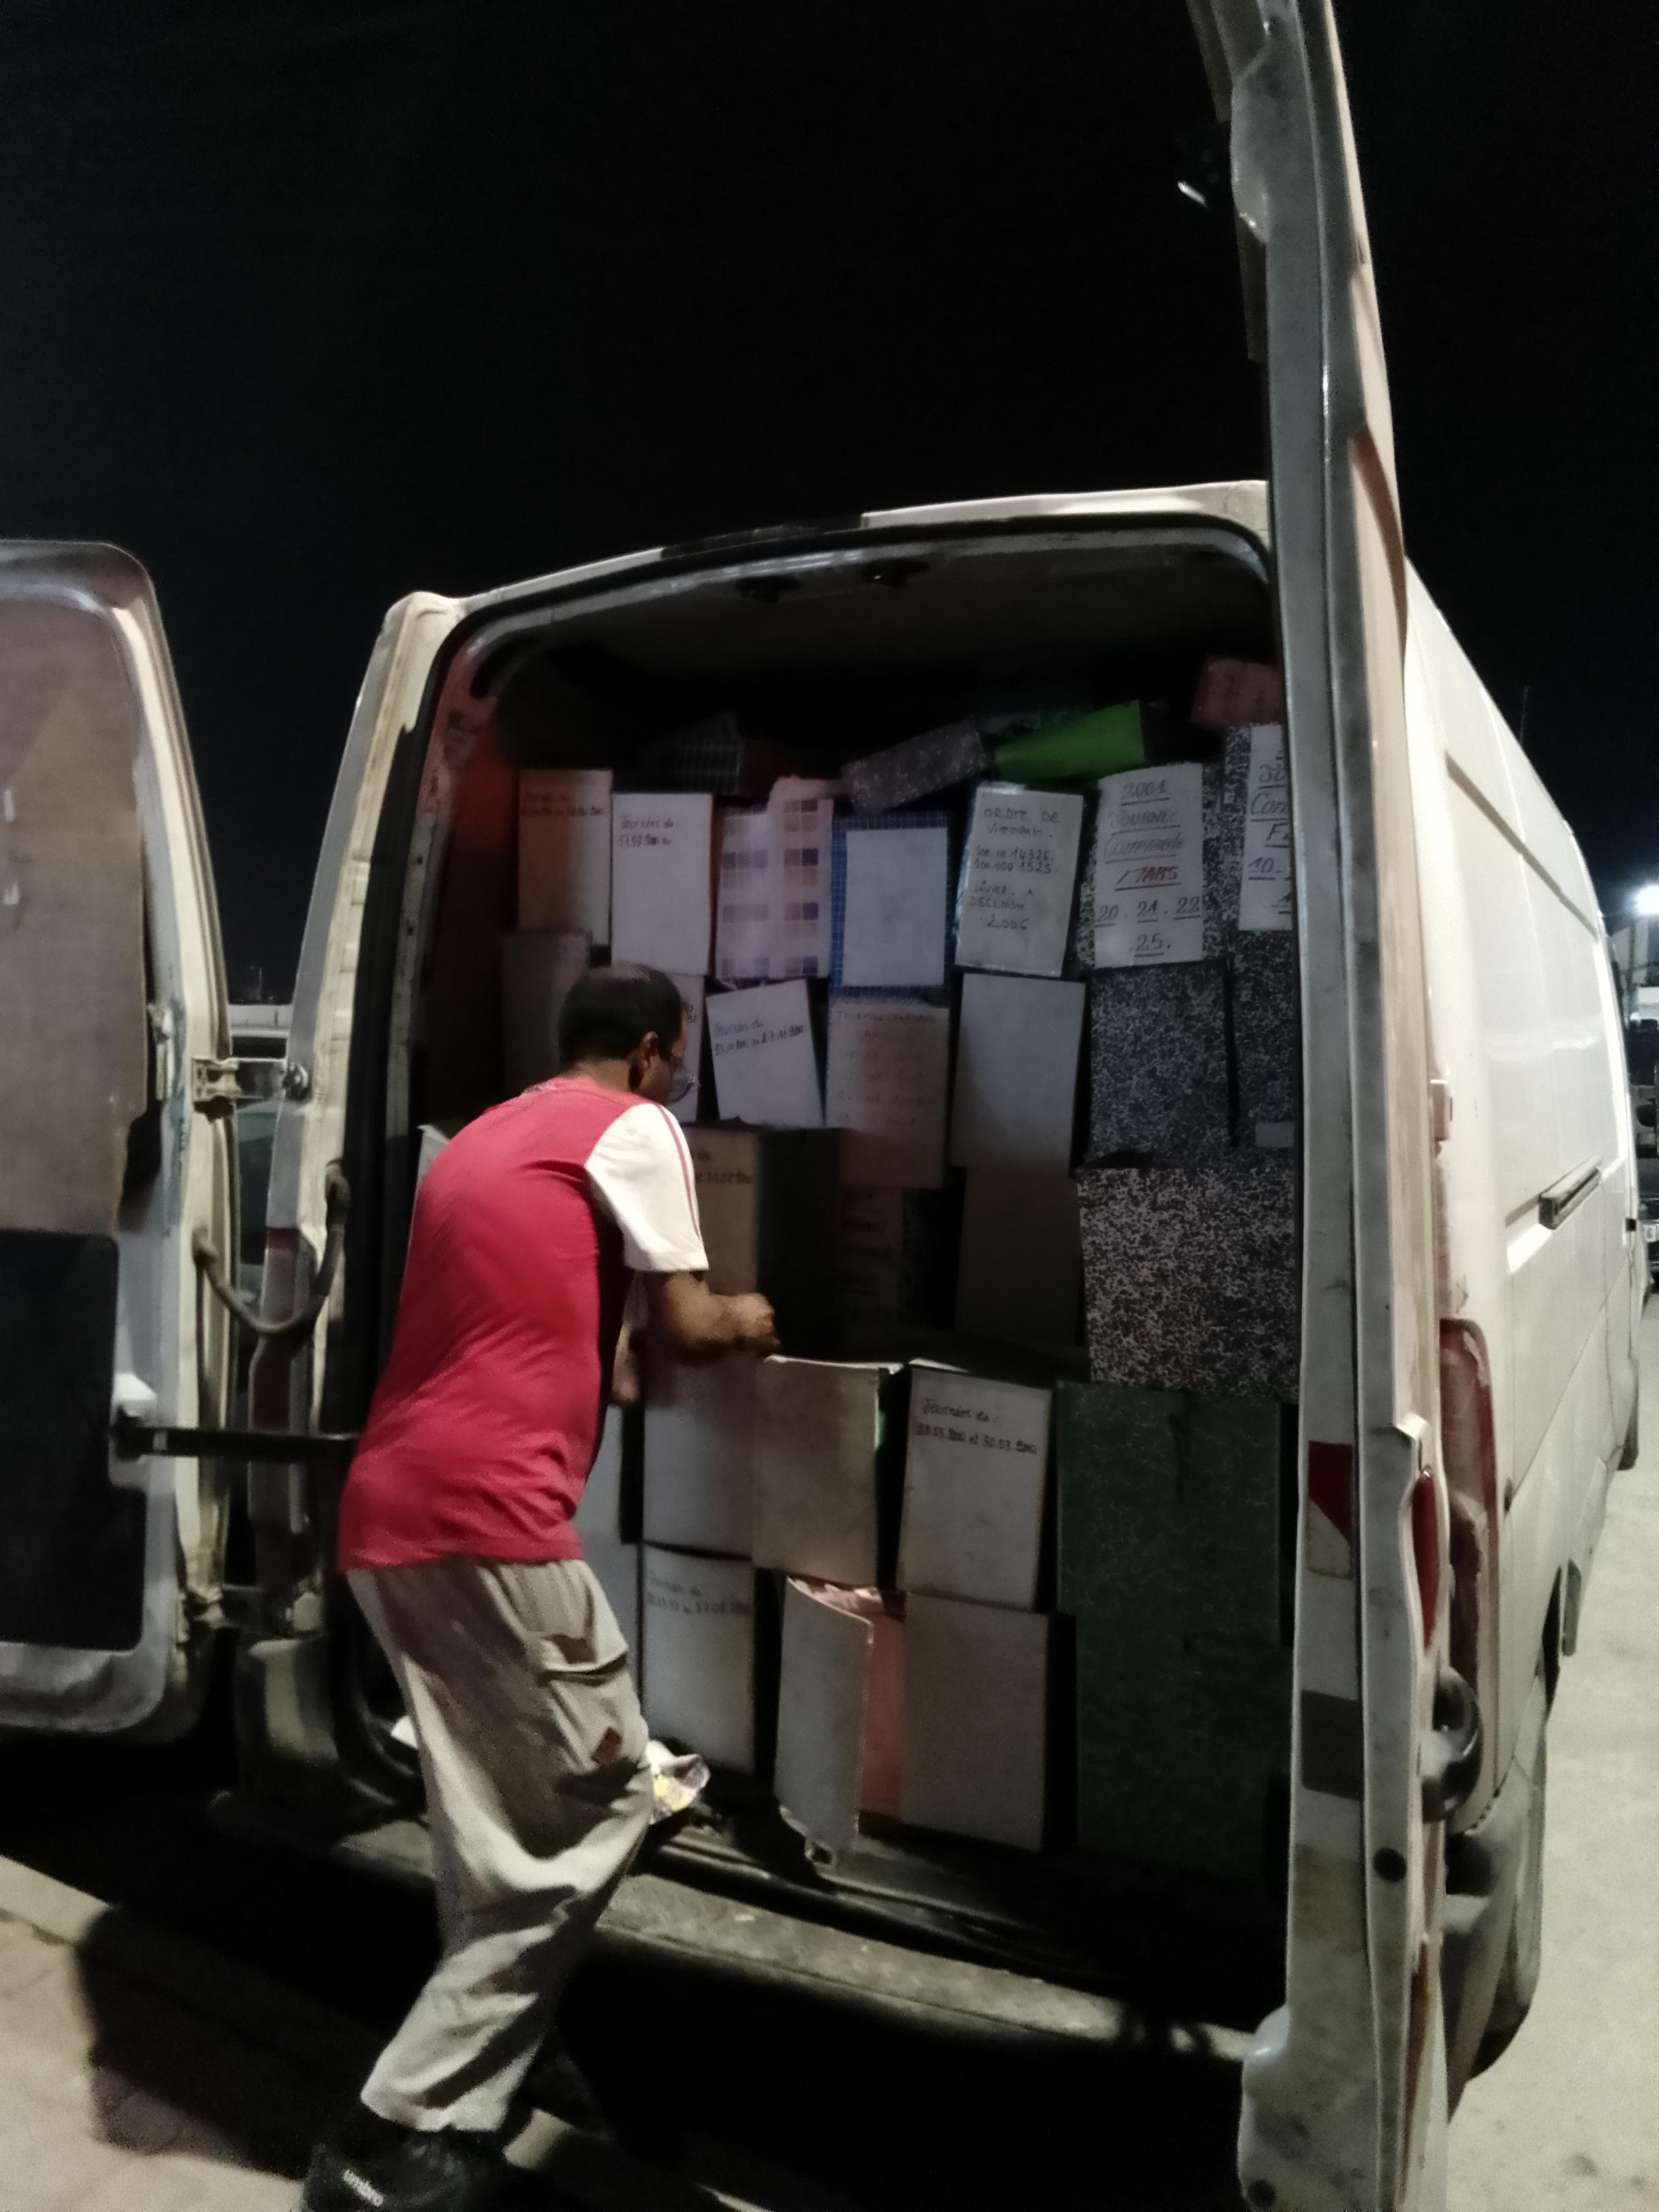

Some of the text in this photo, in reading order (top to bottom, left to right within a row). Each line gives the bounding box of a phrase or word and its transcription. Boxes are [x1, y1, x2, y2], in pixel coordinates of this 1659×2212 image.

[1122, 779, 1167, 799] 2001
[1115, 865, 1179, 885] MARS
[1175, 896, 1201, 914] 22
[986, 914, 1030, 930] 2006
